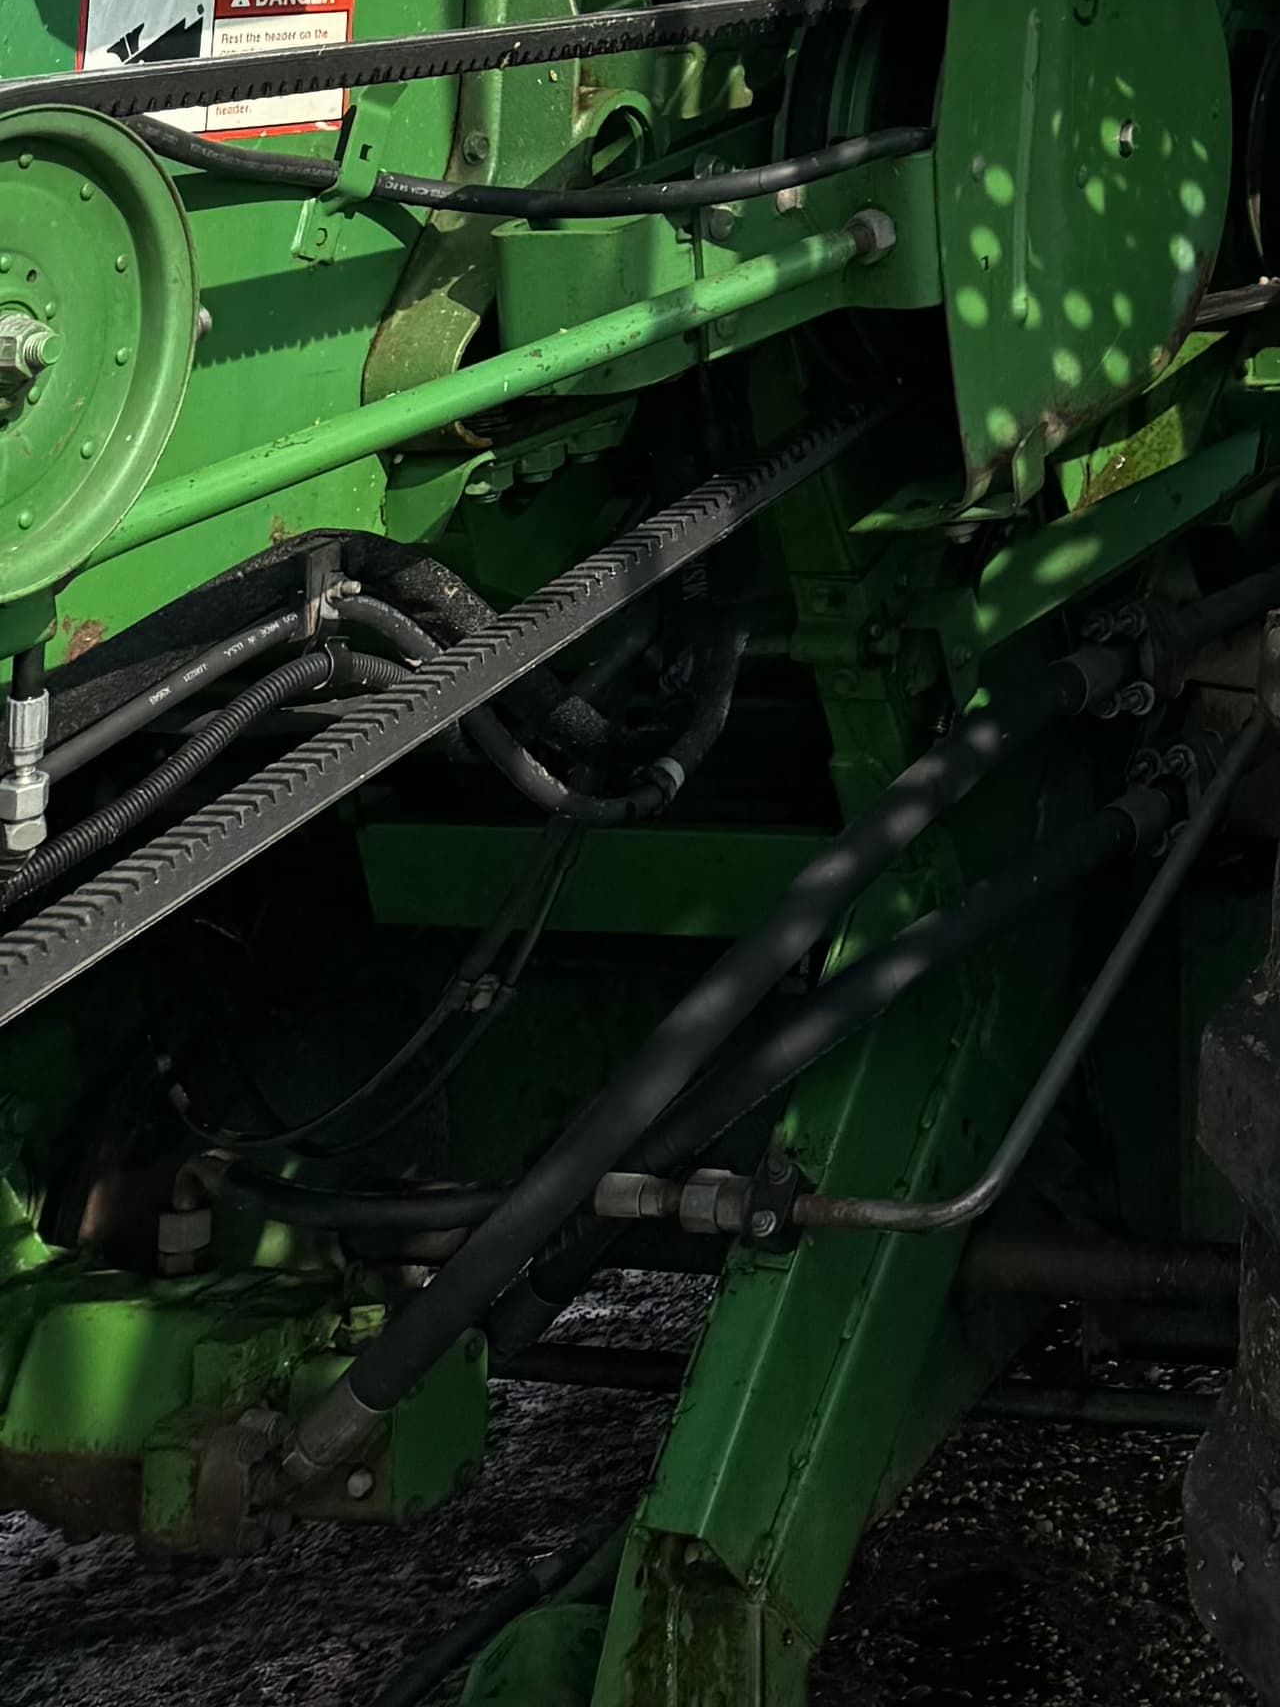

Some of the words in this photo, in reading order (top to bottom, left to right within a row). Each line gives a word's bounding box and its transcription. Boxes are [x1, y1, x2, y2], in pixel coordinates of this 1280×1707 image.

[221, 32, 243, 44] Rest
[246, 31, 261, 43] the
[265, 31, 296, 41] header
[300, 30, 311, 40] on
[315, 29, 328, 39] the
